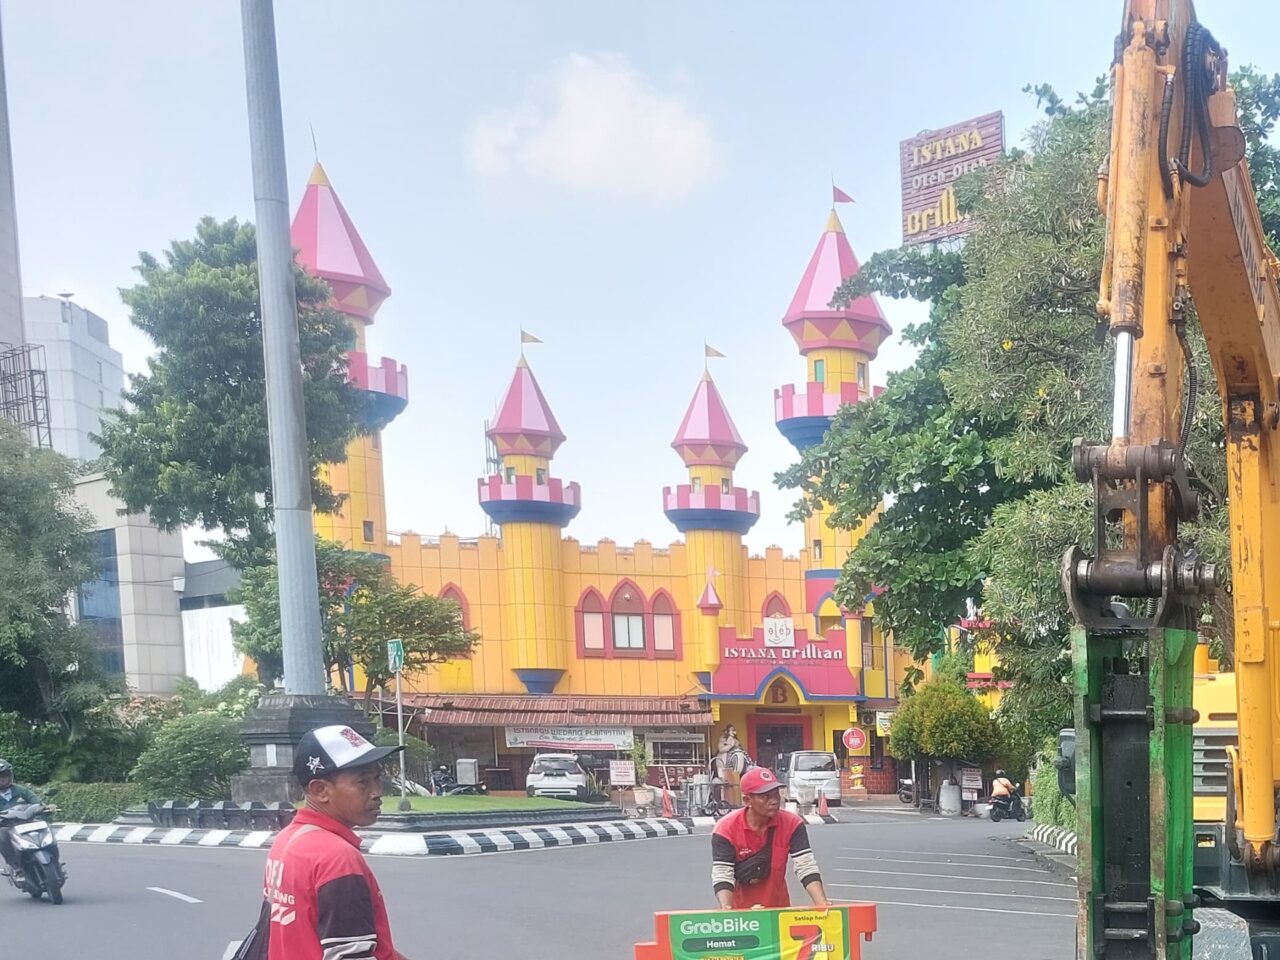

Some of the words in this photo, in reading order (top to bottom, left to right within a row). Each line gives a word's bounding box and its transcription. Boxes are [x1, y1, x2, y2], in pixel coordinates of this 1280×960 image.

[911, 128, 983, 168] ISTANA
[724, 647, 777, 659] ISTANA
[680, 917, 760, 935] GrabBike
[706, 940, 736, 949] Hemat
[811, 944, 835, 952] RIBU
